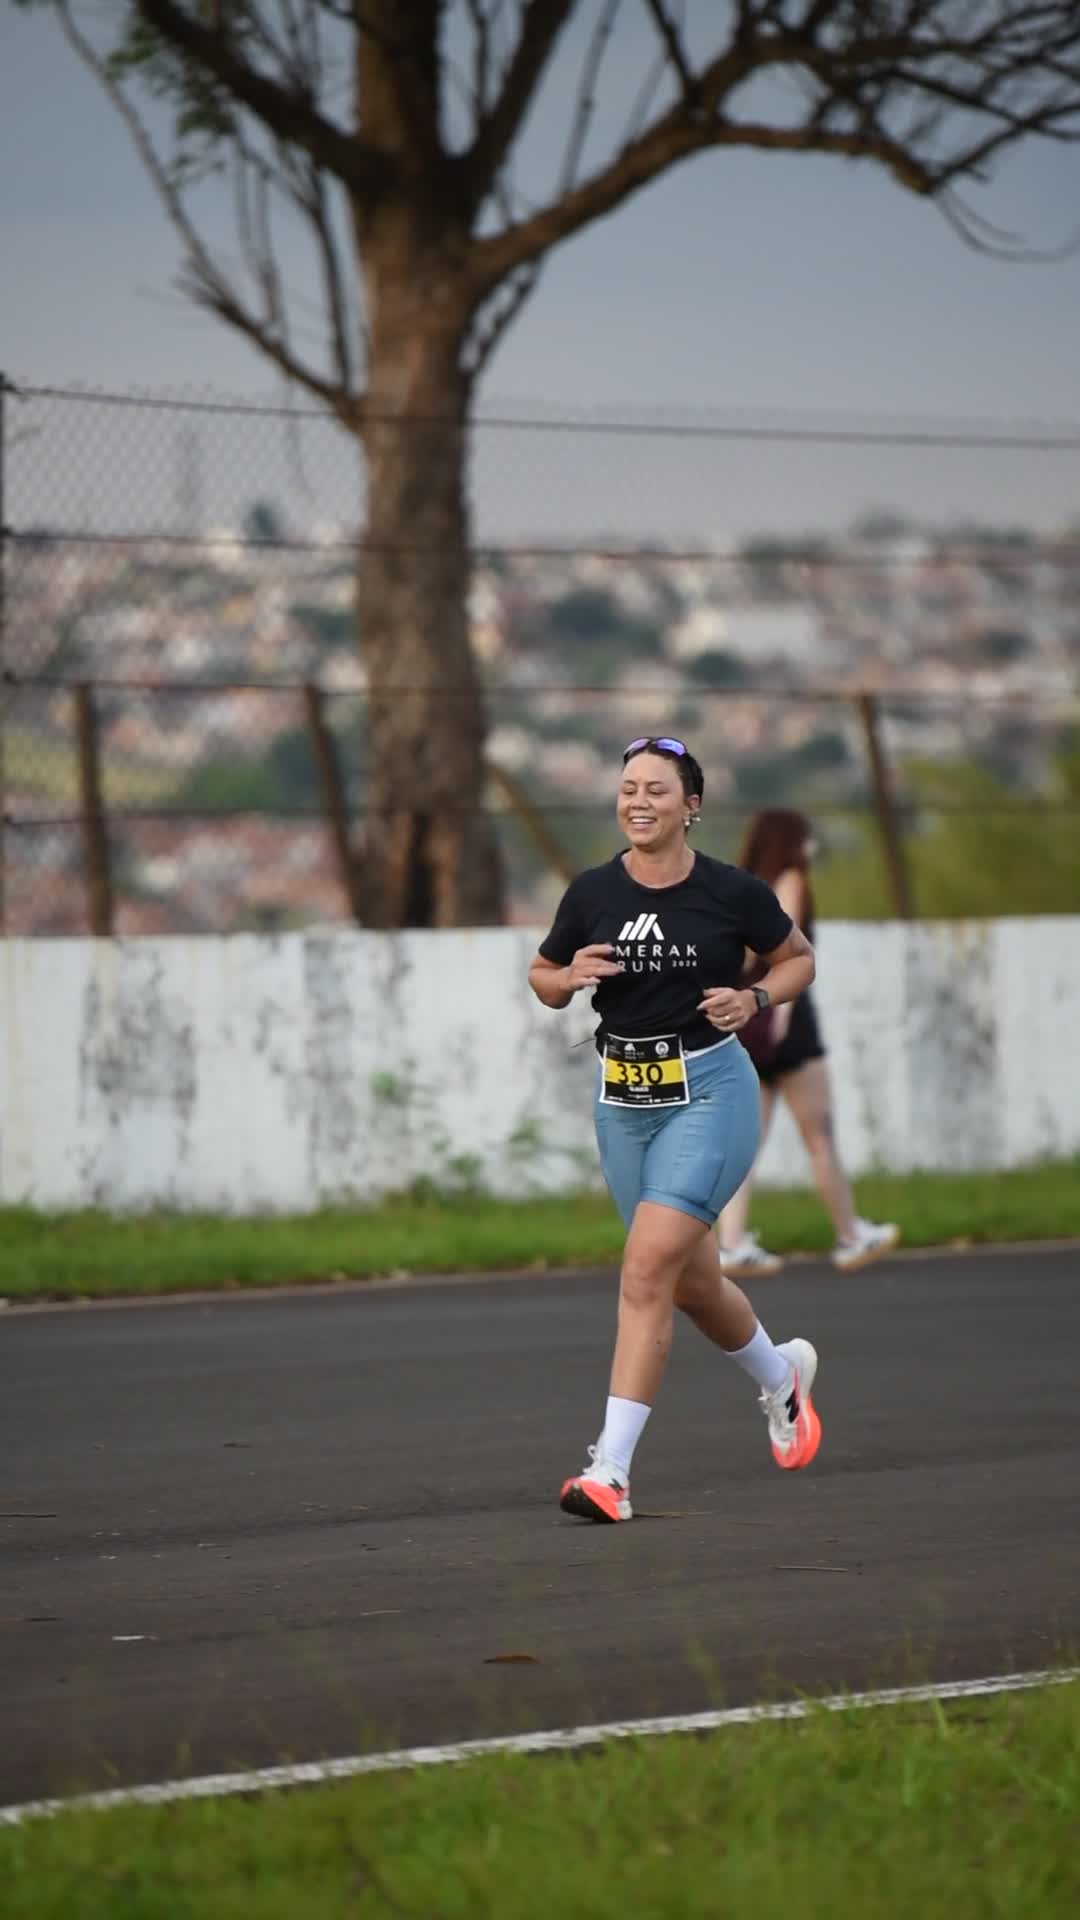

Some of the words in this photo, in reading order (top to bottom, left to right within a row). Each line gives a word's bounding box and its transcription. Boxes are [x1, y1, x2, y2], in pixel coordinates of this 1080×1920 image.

[616, 944, 697, 957] MERAK
[617, 960, 661, 973] RUN
[617, 1063, 663, 1085] 330
